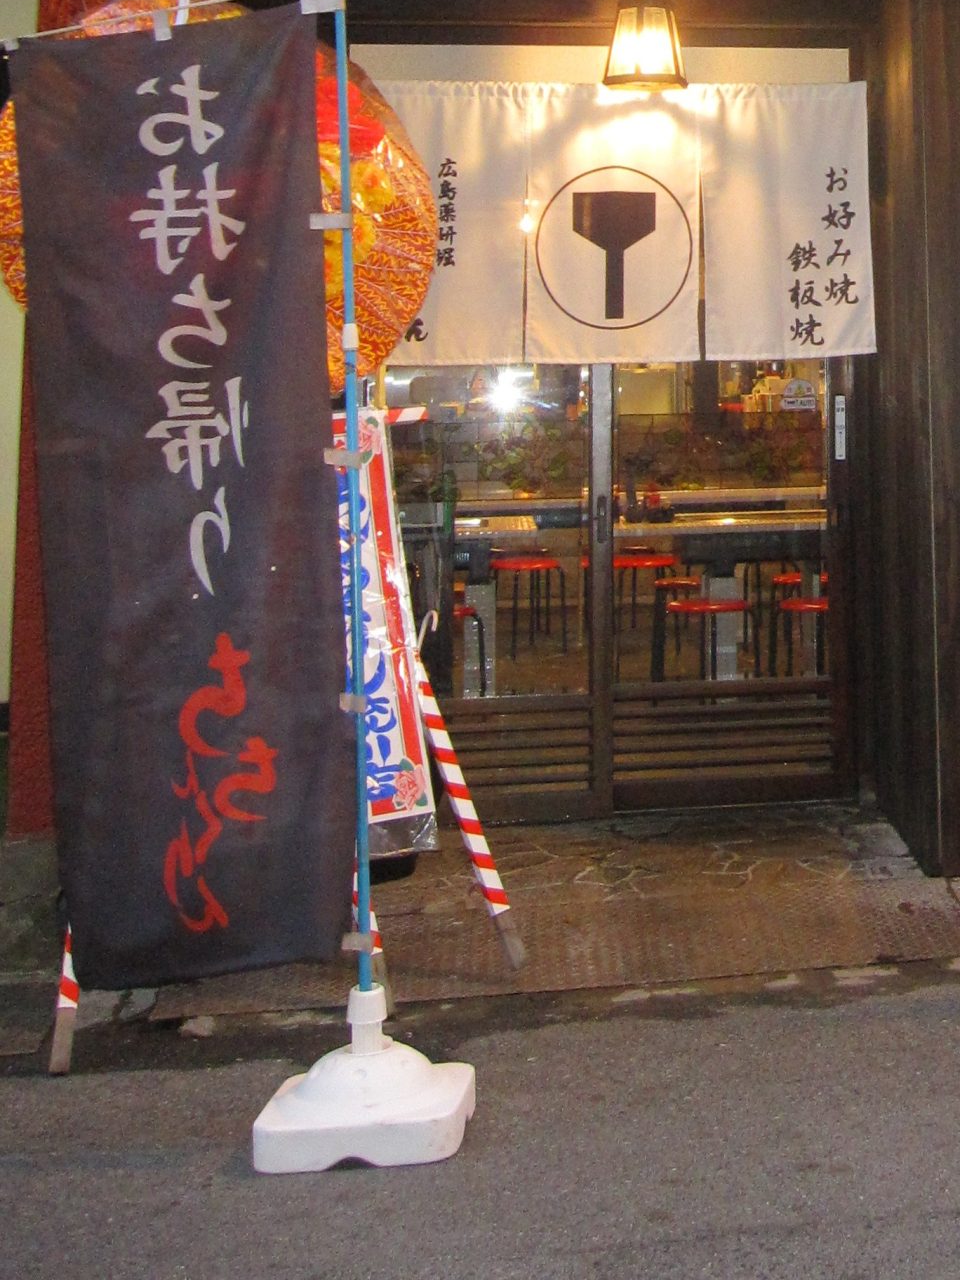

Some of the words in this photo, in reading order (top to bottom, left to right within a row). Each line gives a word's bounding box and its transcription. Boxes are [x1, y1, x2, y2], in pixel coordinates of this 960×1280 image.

[787, 240, 824, 346] 鉄板焼
[821, 166, 859, 305] お好み焼
